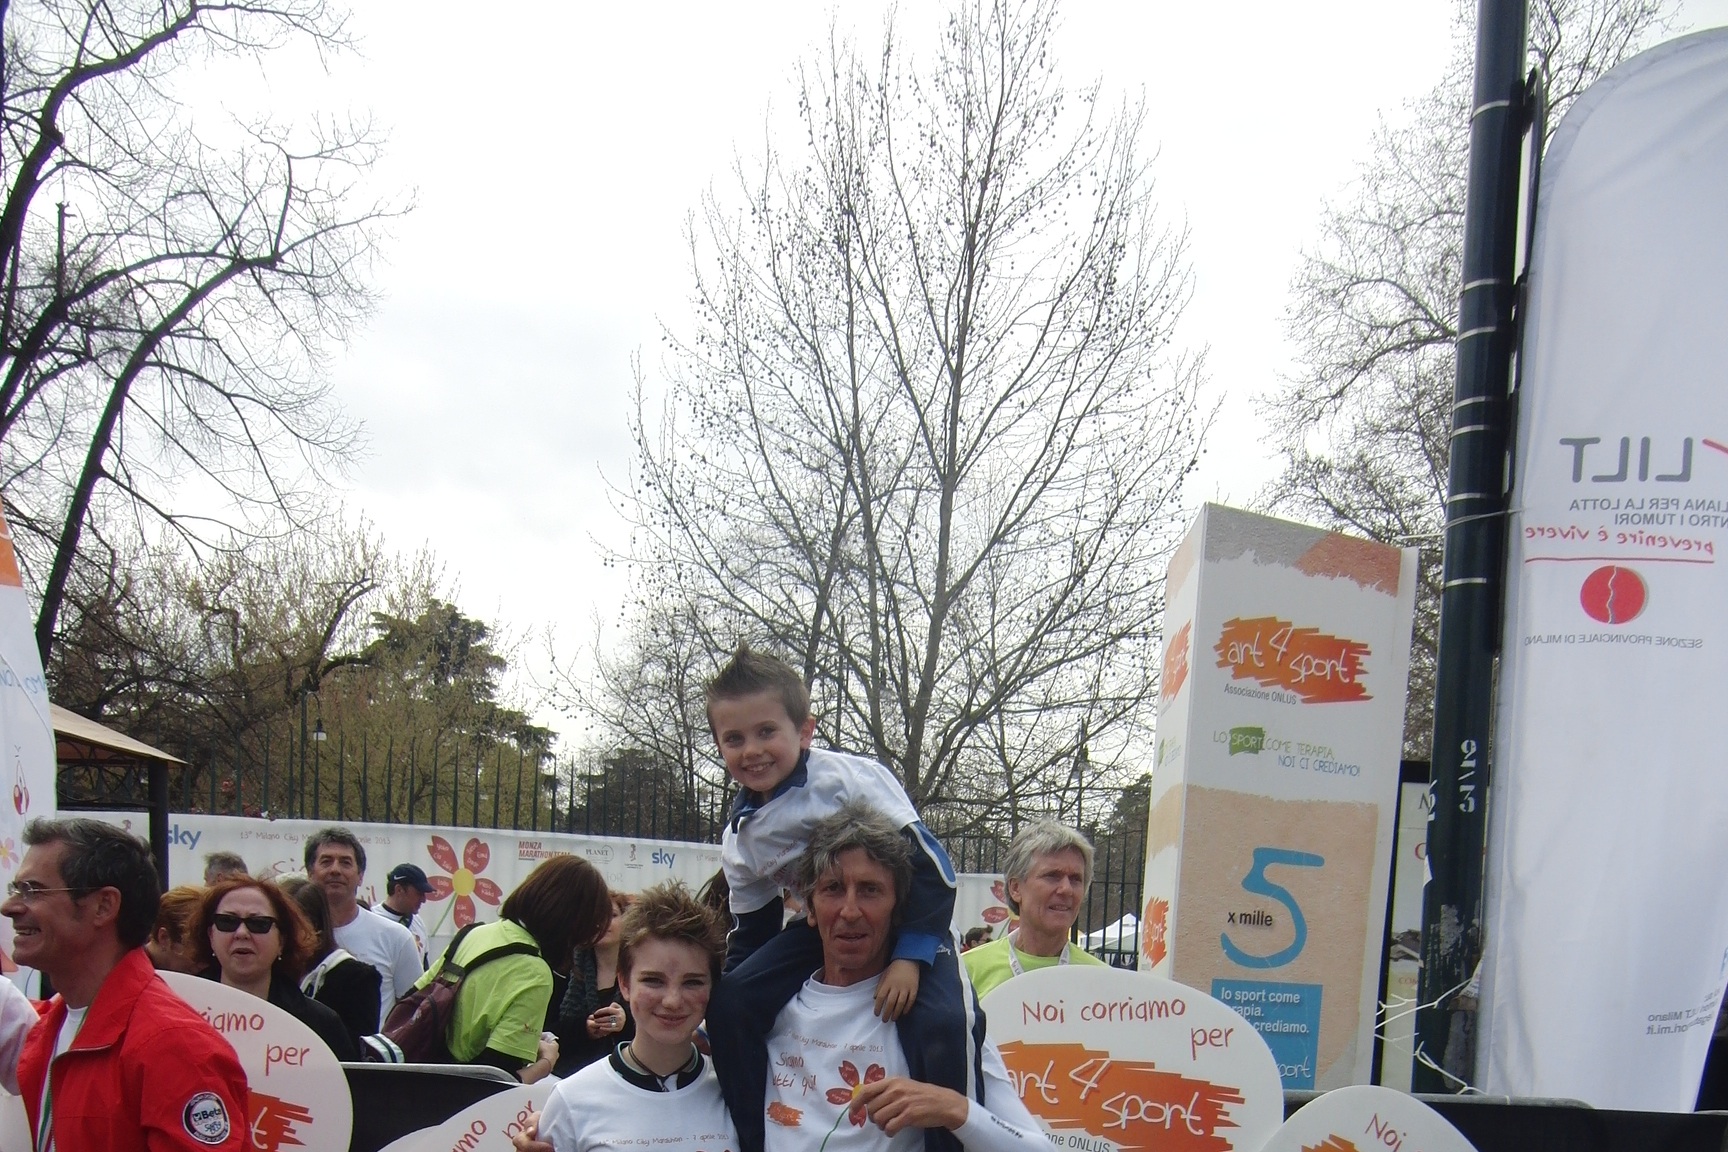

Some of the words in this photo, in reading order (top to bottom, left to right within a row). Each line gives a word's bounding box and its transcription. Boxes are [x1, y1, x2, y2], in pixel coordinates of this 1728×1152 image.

[1227, 631, 1265, 667] art
[1269, 626, 1294, 662] 4
[1289, 648, 1350, 683] sport
[1224, 683, 1270, 700] Associazione
[1271, 691, 1297, 705] ONLUS
[518, 841, 543, 850] MONZA
[652, 848, 676, 868] sky
[1220, 846, 1325, 969] 5
[1227, 911, 1236, 924] x
[1239, 910, 1273, 926] mille
[1235, 989, 1266, 1003] sport
[1268, 992, 1301, 1003] come
[1022, 999, 1065, 1025] Noi
[1080, 997, 1186, 1022] corriamo
[1231, 1004, 1265, 1017] rapia.
[1190, 1026, 1234, 1060] per
[266, 1044, 310, 1076] per
[1277, 1055, 1312, 1078] port
[1069, 1058, 1111, 1100] 4
[1101, 1091, 1205, 1136] sport
[1364, 1112, 1407, 1152] Noi
